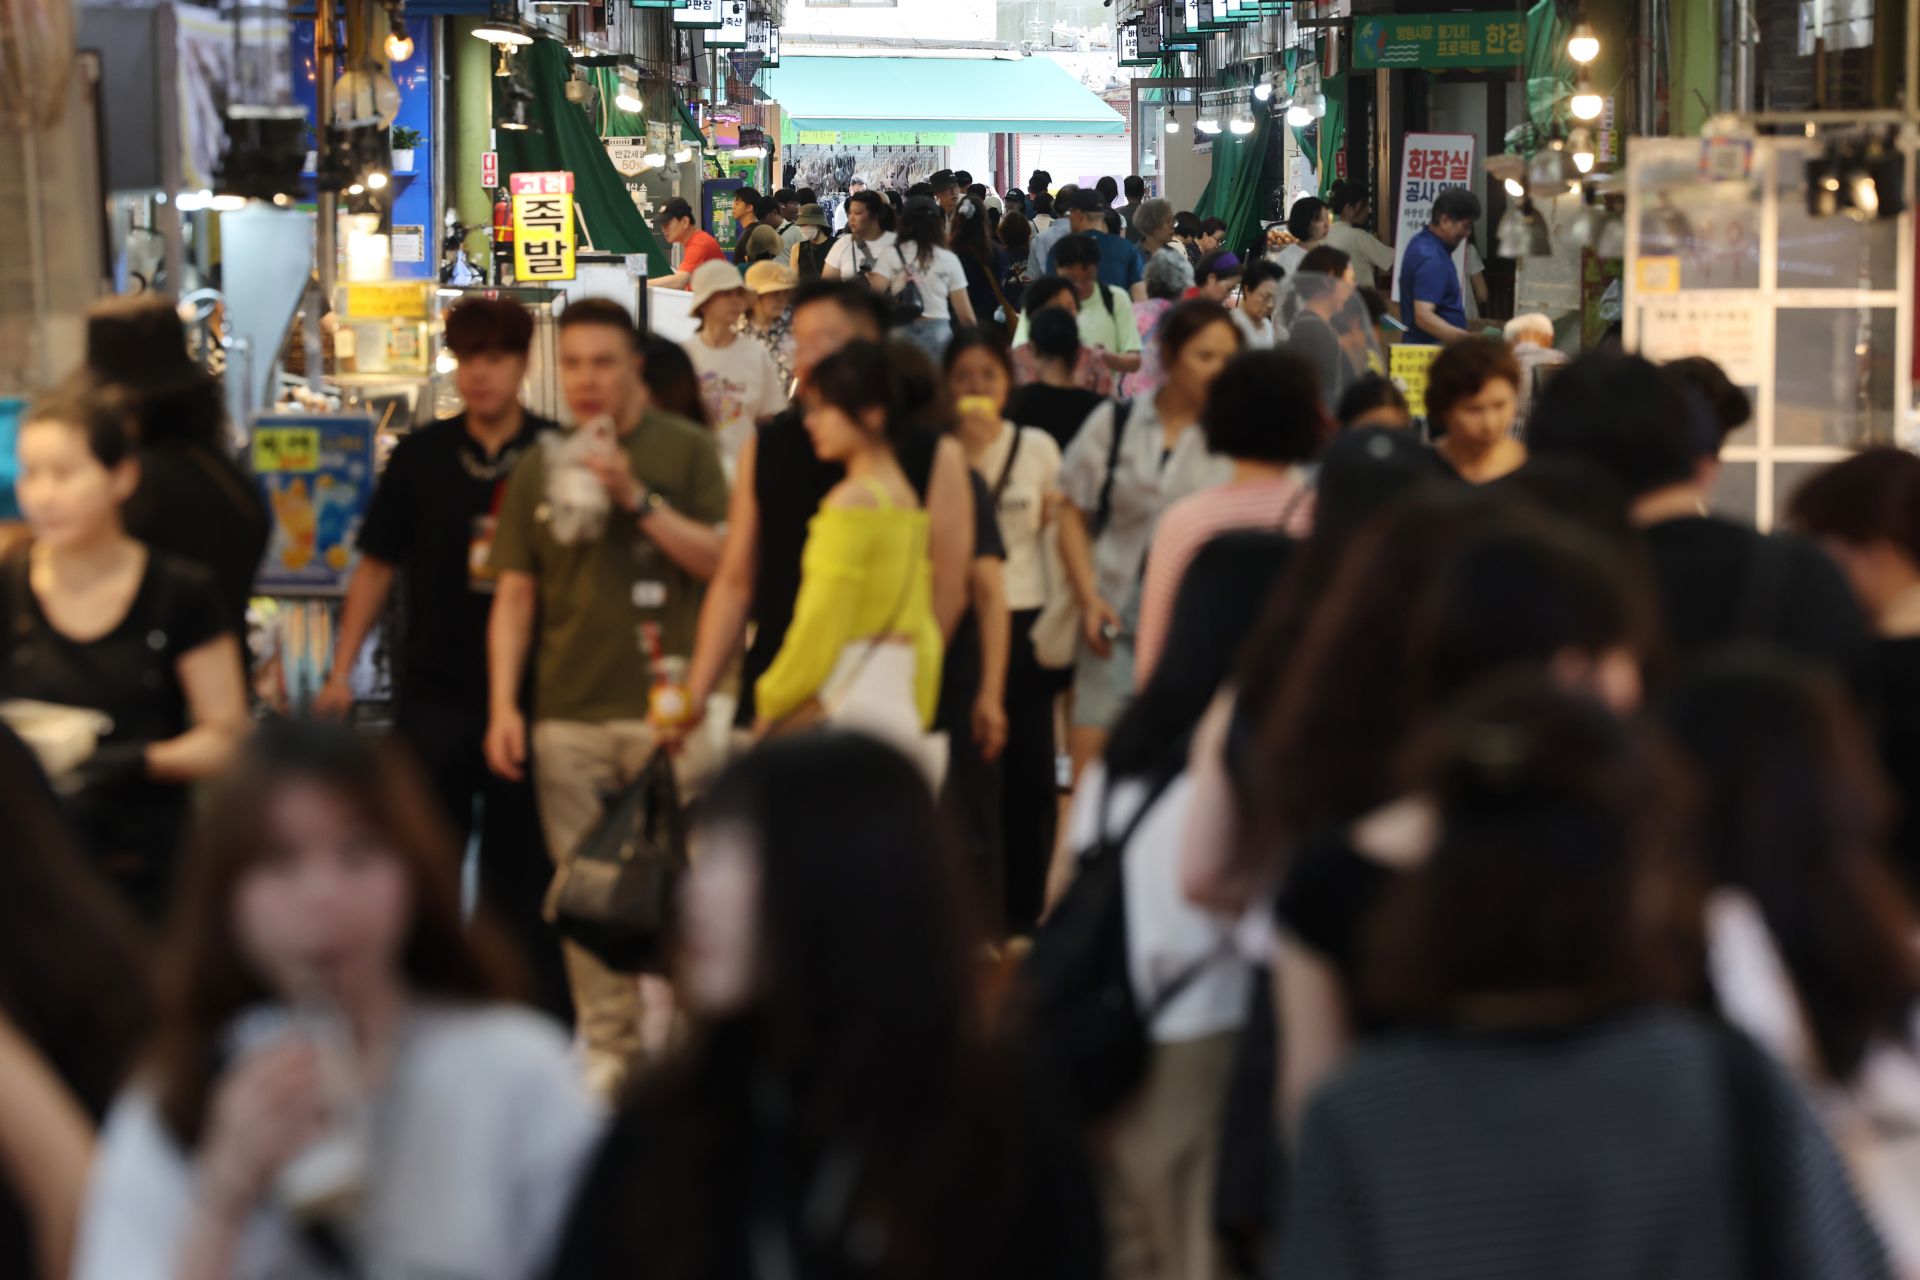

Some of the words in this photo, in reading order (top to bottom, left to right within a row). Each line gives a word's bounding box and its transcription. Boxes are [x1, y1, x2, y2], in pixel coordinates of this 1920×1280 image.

[1437, 40, 1481, 56] 프로젝트
[1407, 148, 1470, 180] 화장실
[1406, 181, 1435, 203] 공사
[523, 199, 568, 274] 족발
